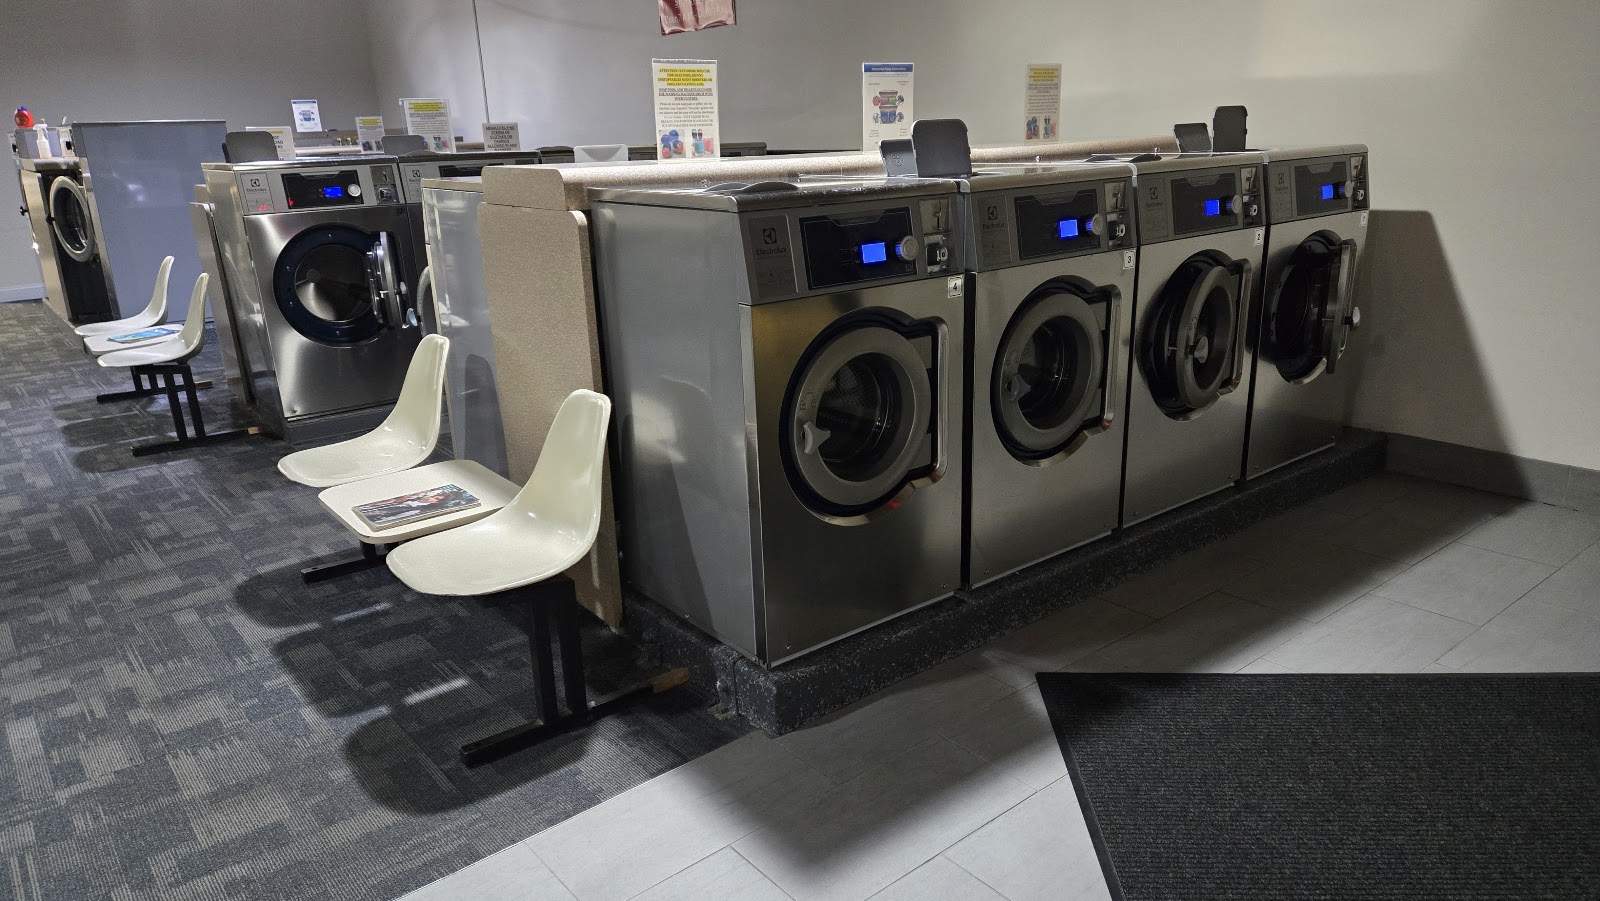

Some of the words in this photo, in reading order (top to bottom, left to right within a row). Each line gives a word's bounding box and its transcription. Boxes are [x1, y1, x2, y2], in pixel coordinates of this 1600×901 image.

[756, 247, 787, 256] Electrolux
[1127, 255, 1132, 264] 3
[952, 282, 958, 292] 4
